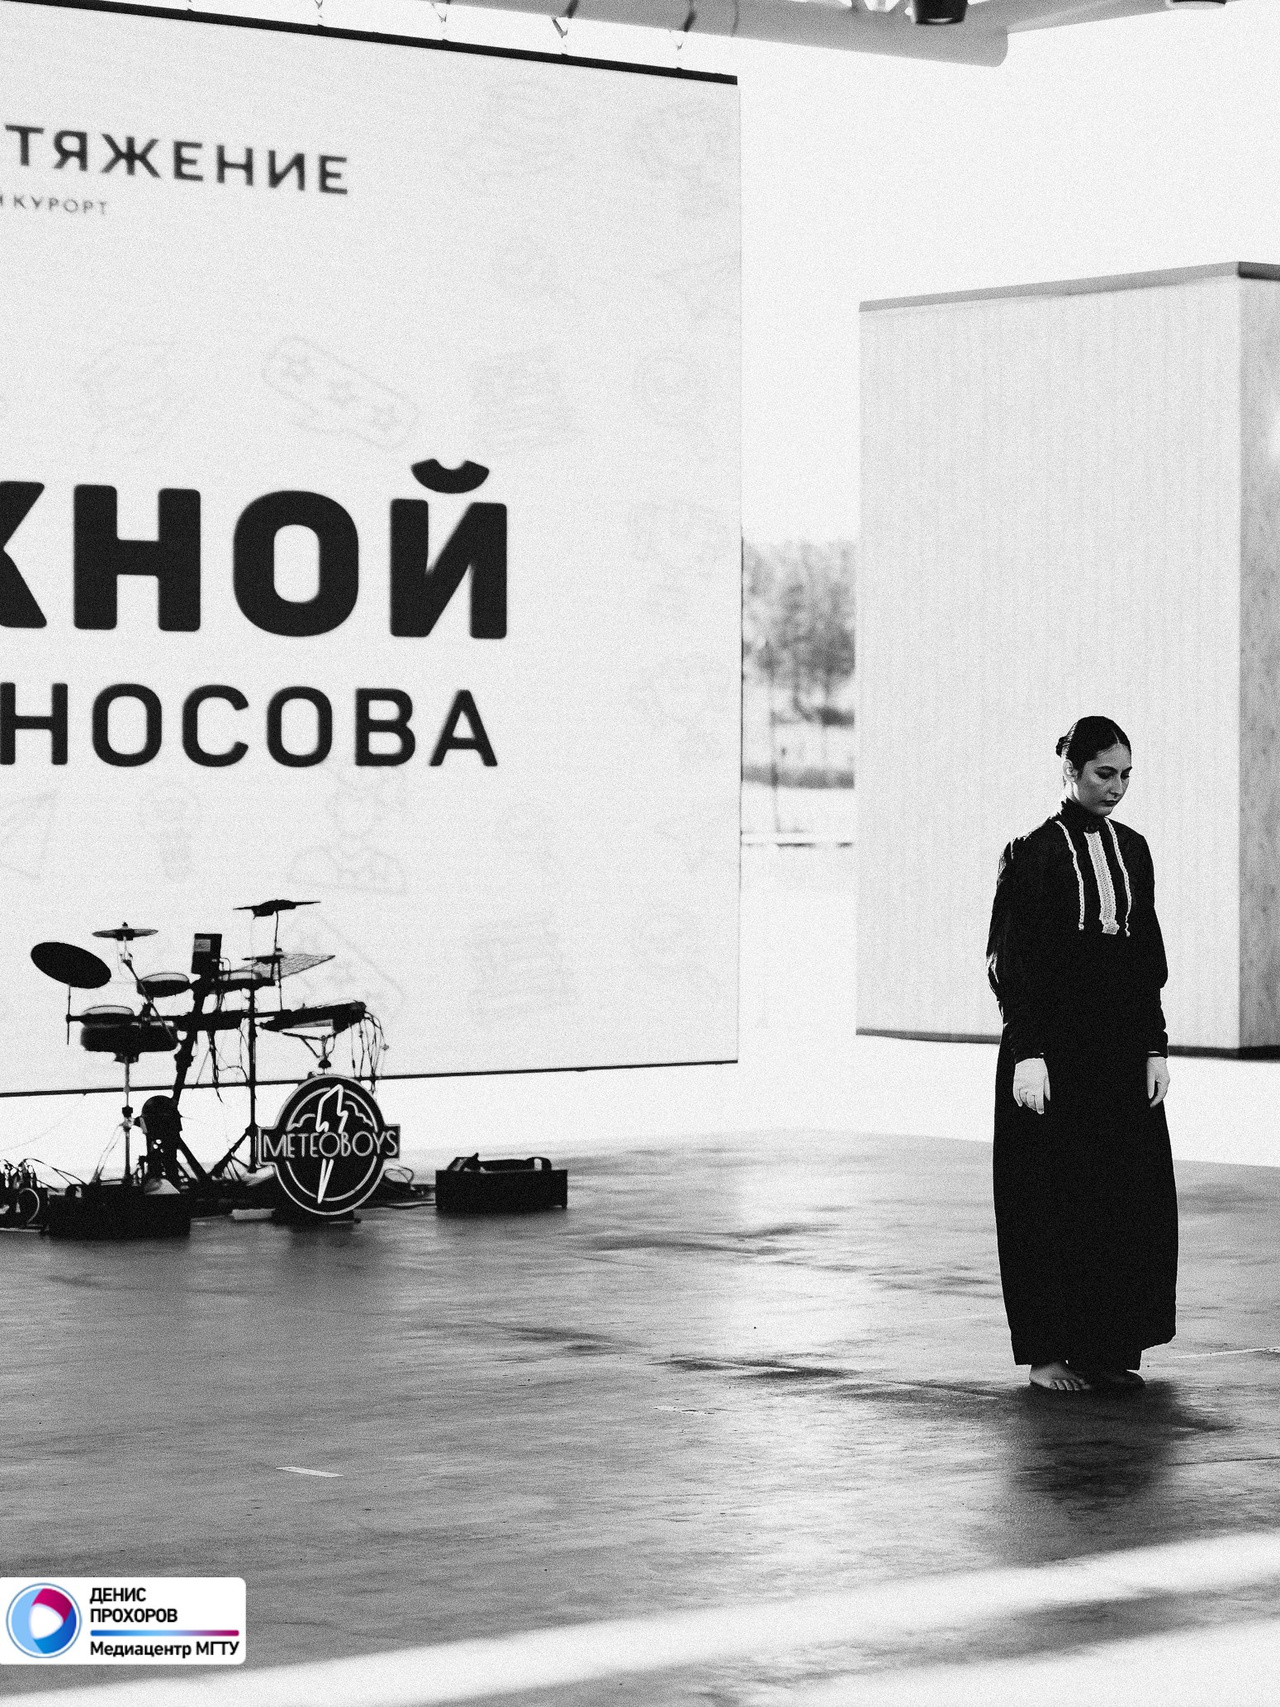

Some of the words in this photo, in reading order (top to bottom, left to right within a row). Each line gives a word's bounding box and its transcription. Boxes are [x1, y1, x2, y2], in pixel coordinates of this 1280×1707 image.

[5, 124, 348, 195] ТЯЖЕНИЕ
[13, 195, 107, 214] КУРОРТ
[0, 682, 498, 768] НОСОВА
[263, 1130, 398, 1158] METEOBOYS
